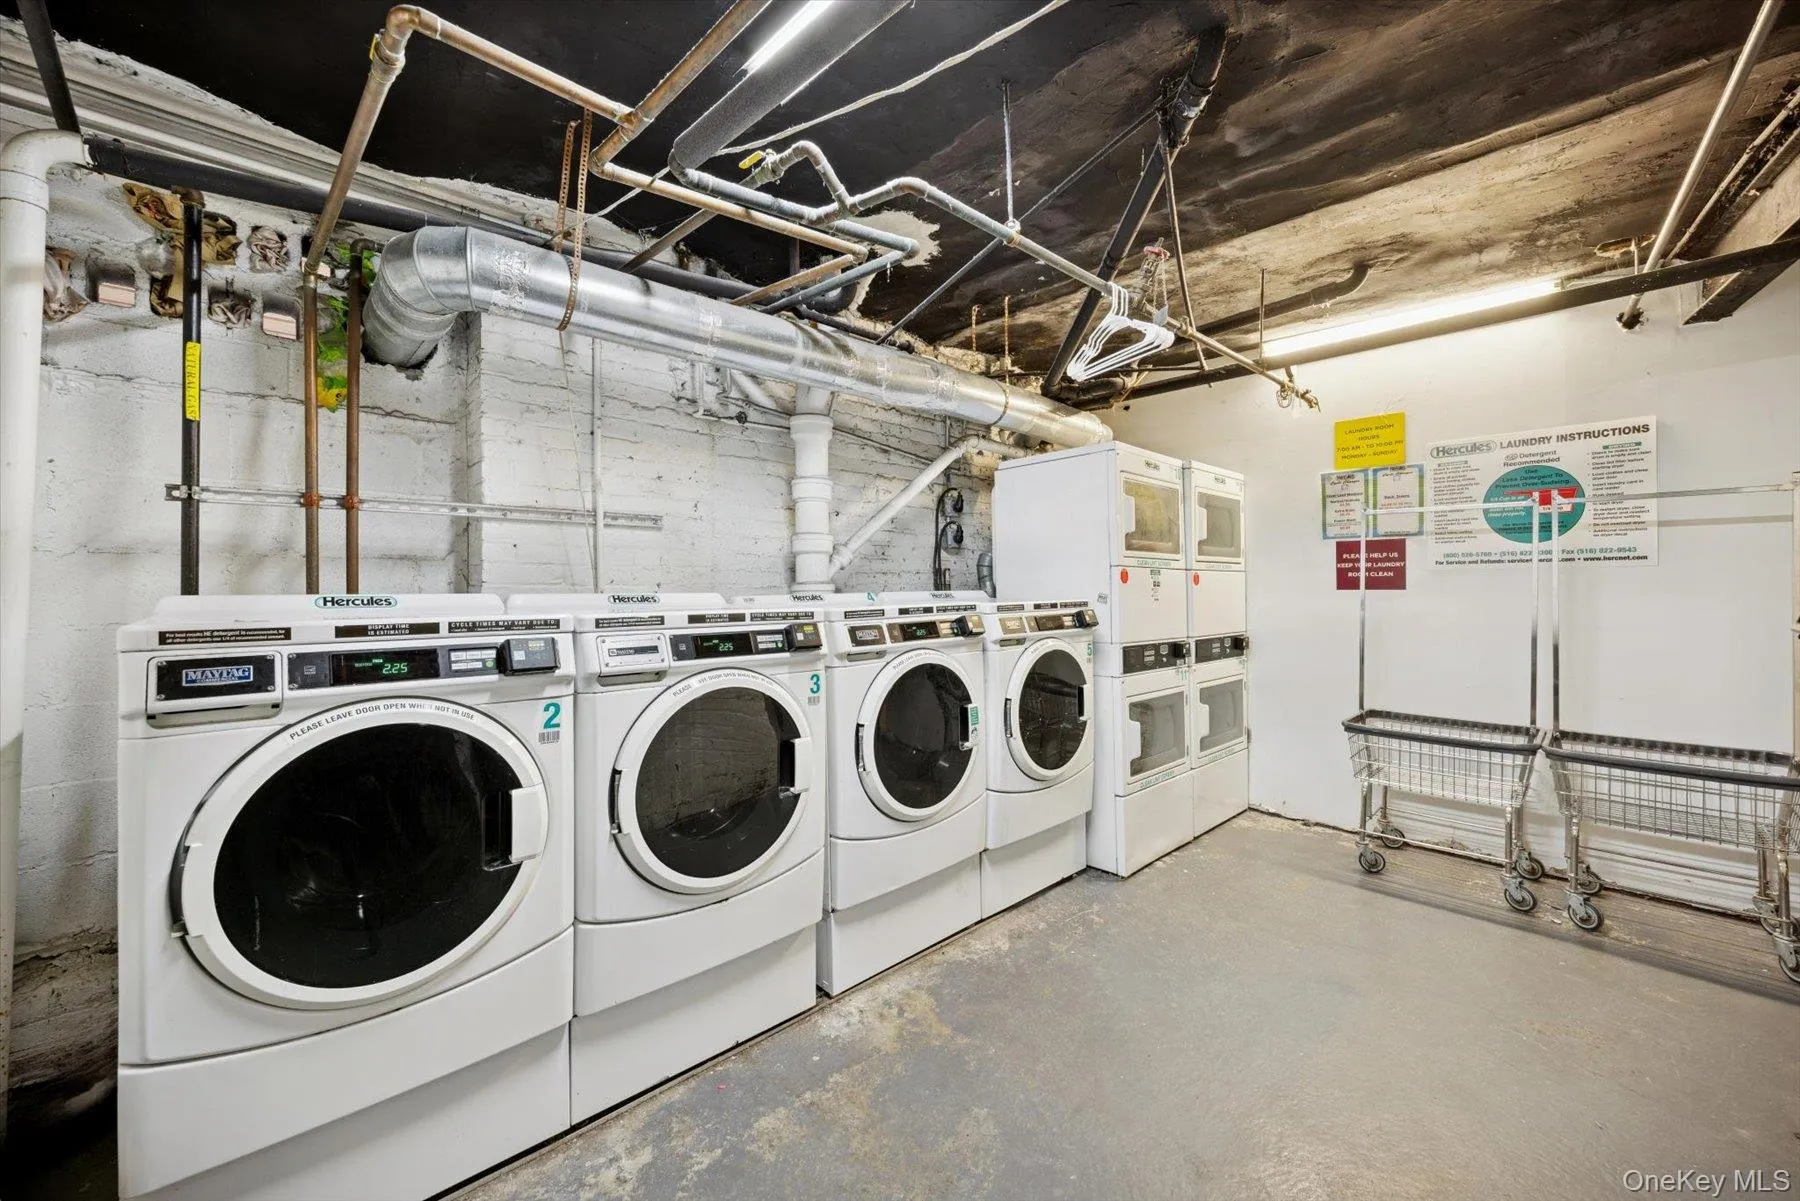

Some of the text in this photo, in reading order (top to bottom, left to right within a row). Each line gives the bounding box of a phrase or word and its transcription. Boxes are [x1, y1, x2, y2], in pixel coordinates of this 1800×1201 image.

[187, 344, 196, 418] NATURAL GAS
[1436, 442, 1492, 456] Hercules
[1500, 436, 1552, 449] LAUNDRY
[1557, 424, 1650, 442] INSTRUCTIONS
[1519, 450, 1556, 458] Detergent
[1504, 457, 1560, 467] Recommended
[323, 596, 392, 606] Hercules
[1087, 643, 1092, 656] 5
[187, 668, 249, 680] MAYTAG
[382, 662, 408, 674] 2.25
[810, 674, 821, 694] 3
[543, 702, 560, 729] 2
[289, 721, 324, 740] PLEASE
[325, 711, 353, 724] LEAVE
[355, 705, 380, 715] DOOR
[461, 710, 475, 720] USE
